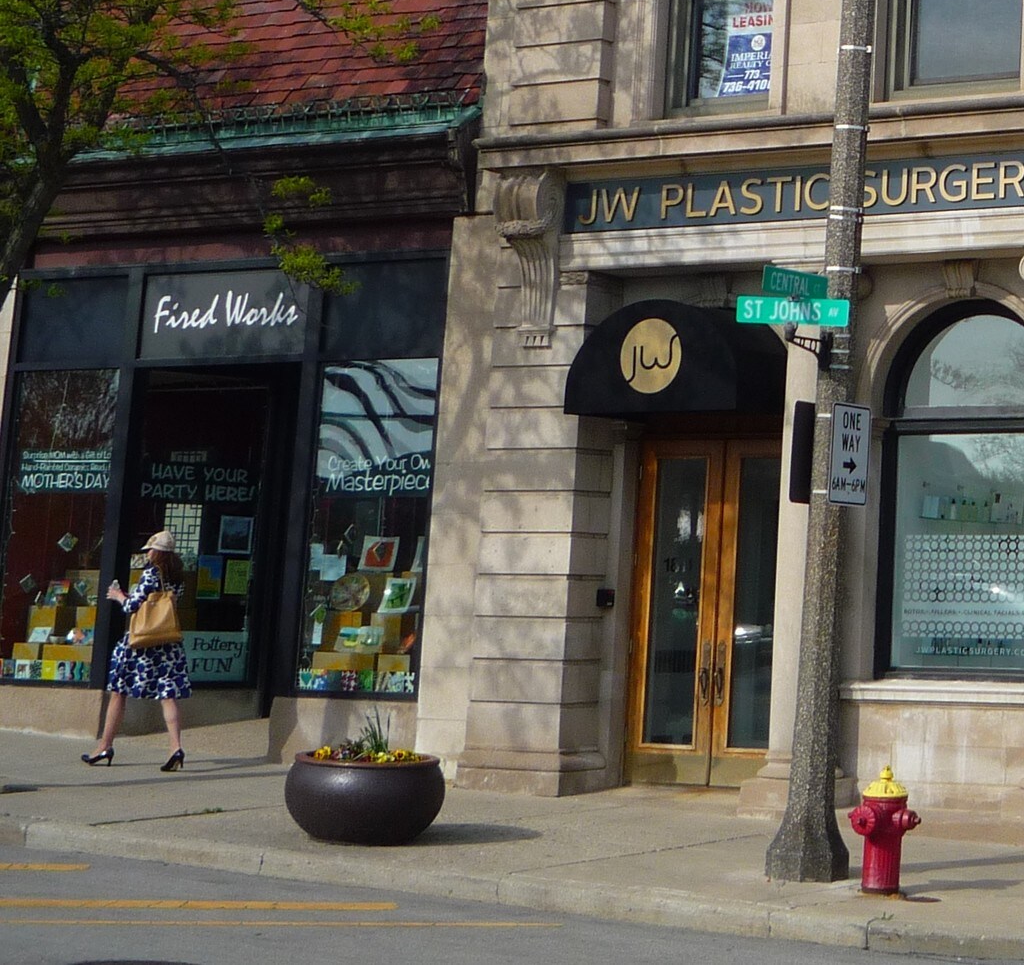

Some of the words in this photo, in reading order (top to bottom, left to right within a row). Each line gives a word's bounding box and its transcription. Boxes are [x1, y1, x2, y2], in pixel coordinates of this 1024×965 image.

[744, 70, 760, 80] 773
[578, 186, 641, 225] JW
[660, 173, 831, 219] PLASTIC
[770, 271, 810, 296] CENTRAL
[154, 294, 219, 333] Fired
[225, 290, 298, 327] Works
[743, 300, 763, 319] ST
[769, 299, 822, 321] JOHNS
[842, 411, 862, 431] ONE
[841, 433, 861, 452] WAY
[328, 455, 372, 471] Create
[376, 454, 408, 471] Your
[21, 472, 83, 489] MOTHER'S
[85, 473, 110, 489] DAY
[151, 463, 196, 481] HAVE
[203, 467, 248, 484] YOUR
[141, 482, 198, 499] PARTY
[205, 484, 256, 502] HERE!
[191, 636, 244, 659] Pottery
